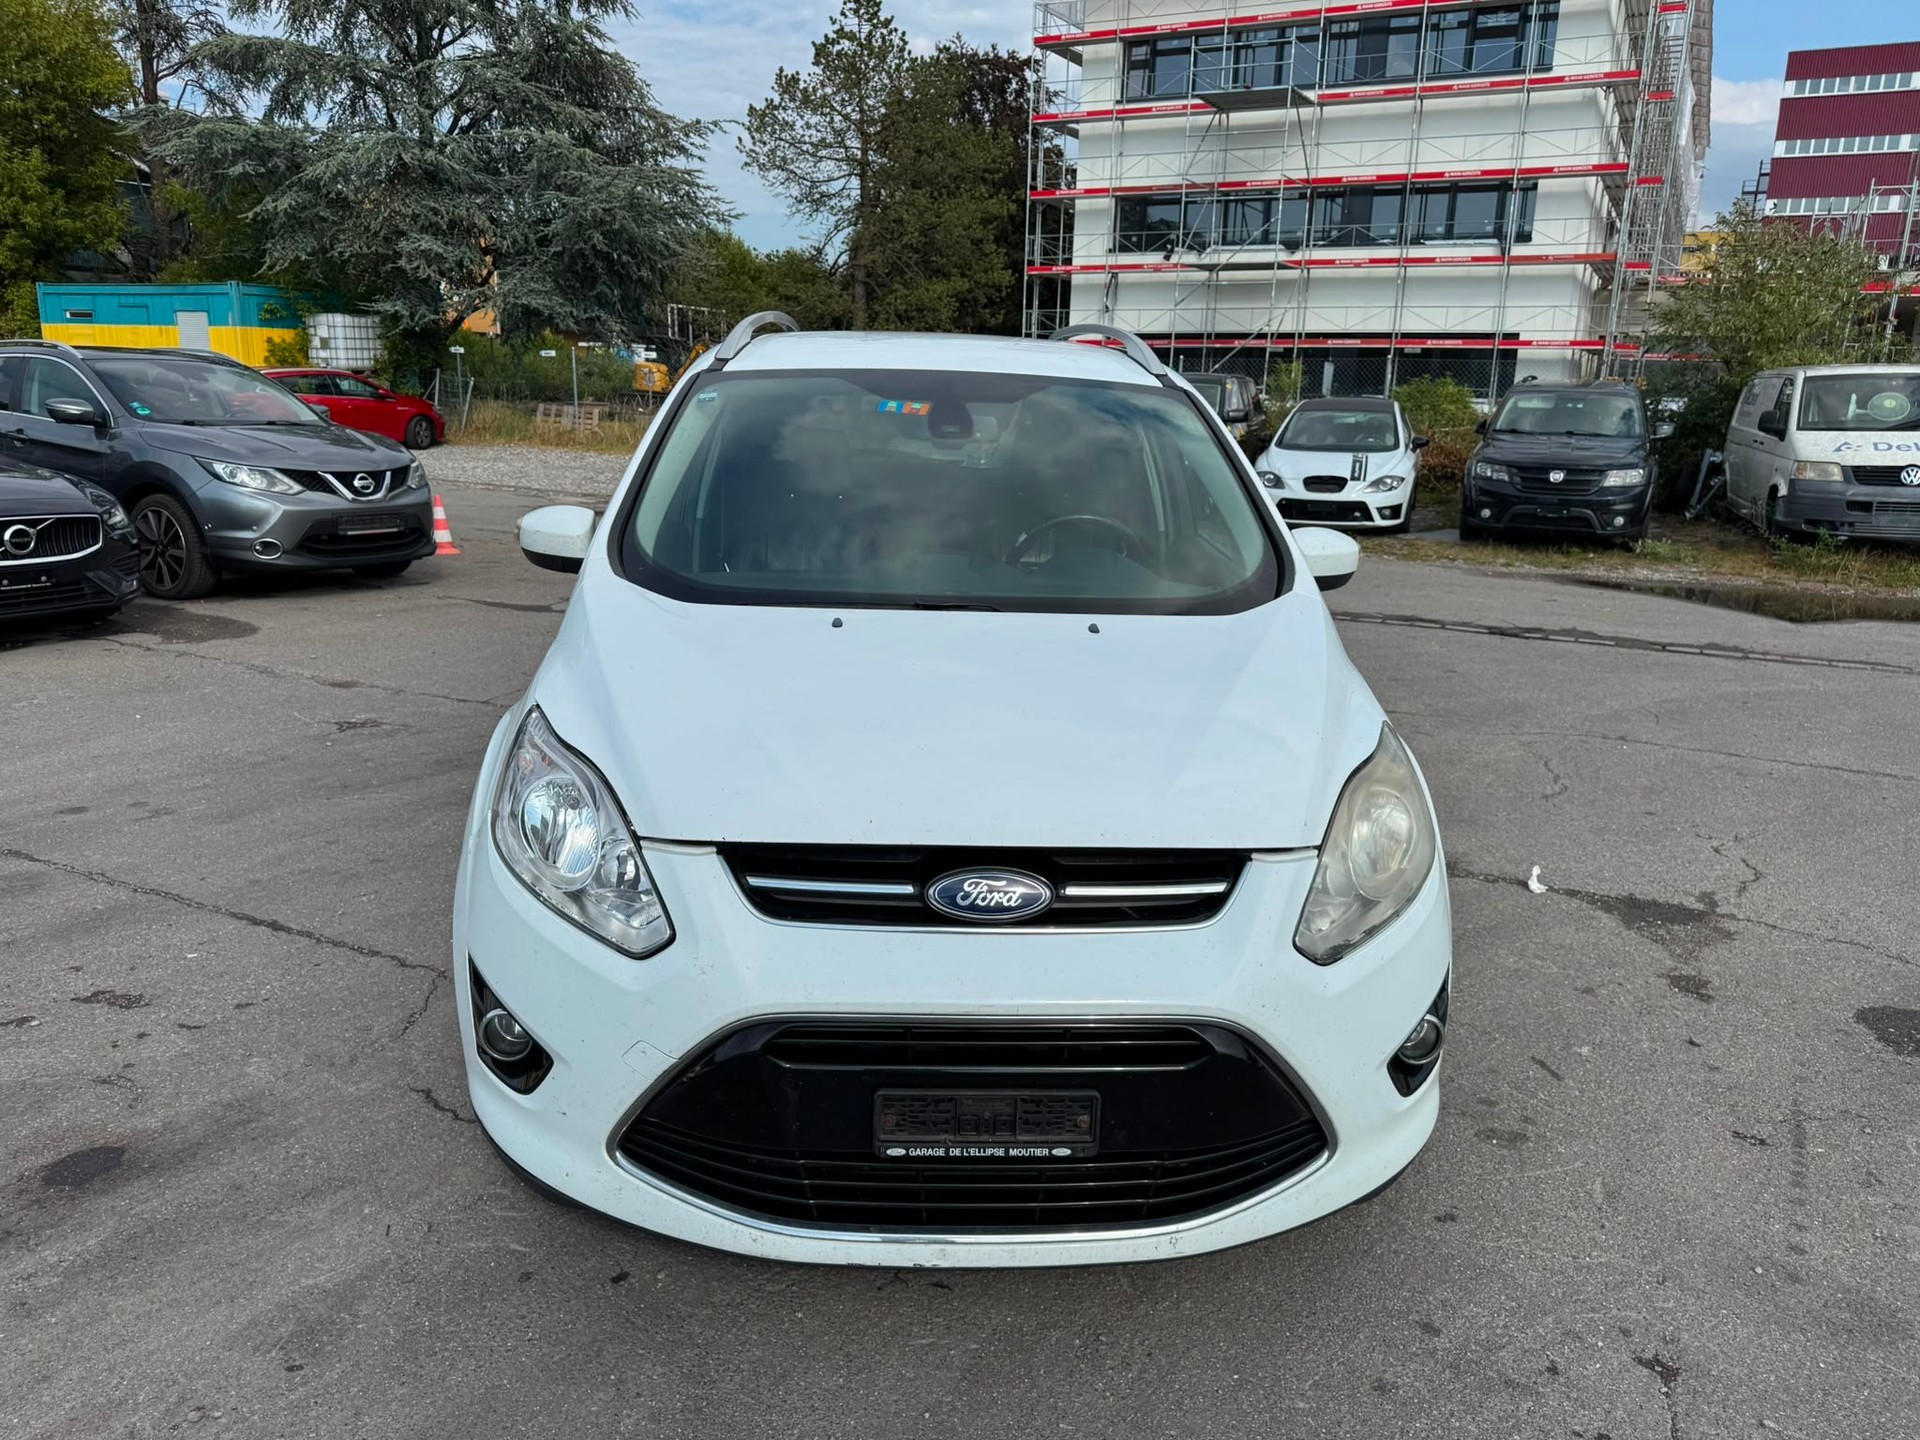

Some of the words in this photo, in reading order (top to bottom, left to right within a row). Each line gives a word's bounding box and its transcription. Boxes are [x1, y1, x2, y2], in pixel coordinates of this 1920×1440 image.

[956, 878, 1022, 907] Ford
[908, 1148, 945, 1156] GARAGE
[949, 1148, 962, 1156] DE
[963, 1148, 1005, 1156] L'ELLIPSE
[1009, 1148, 1049, 1156] MOUTIER
